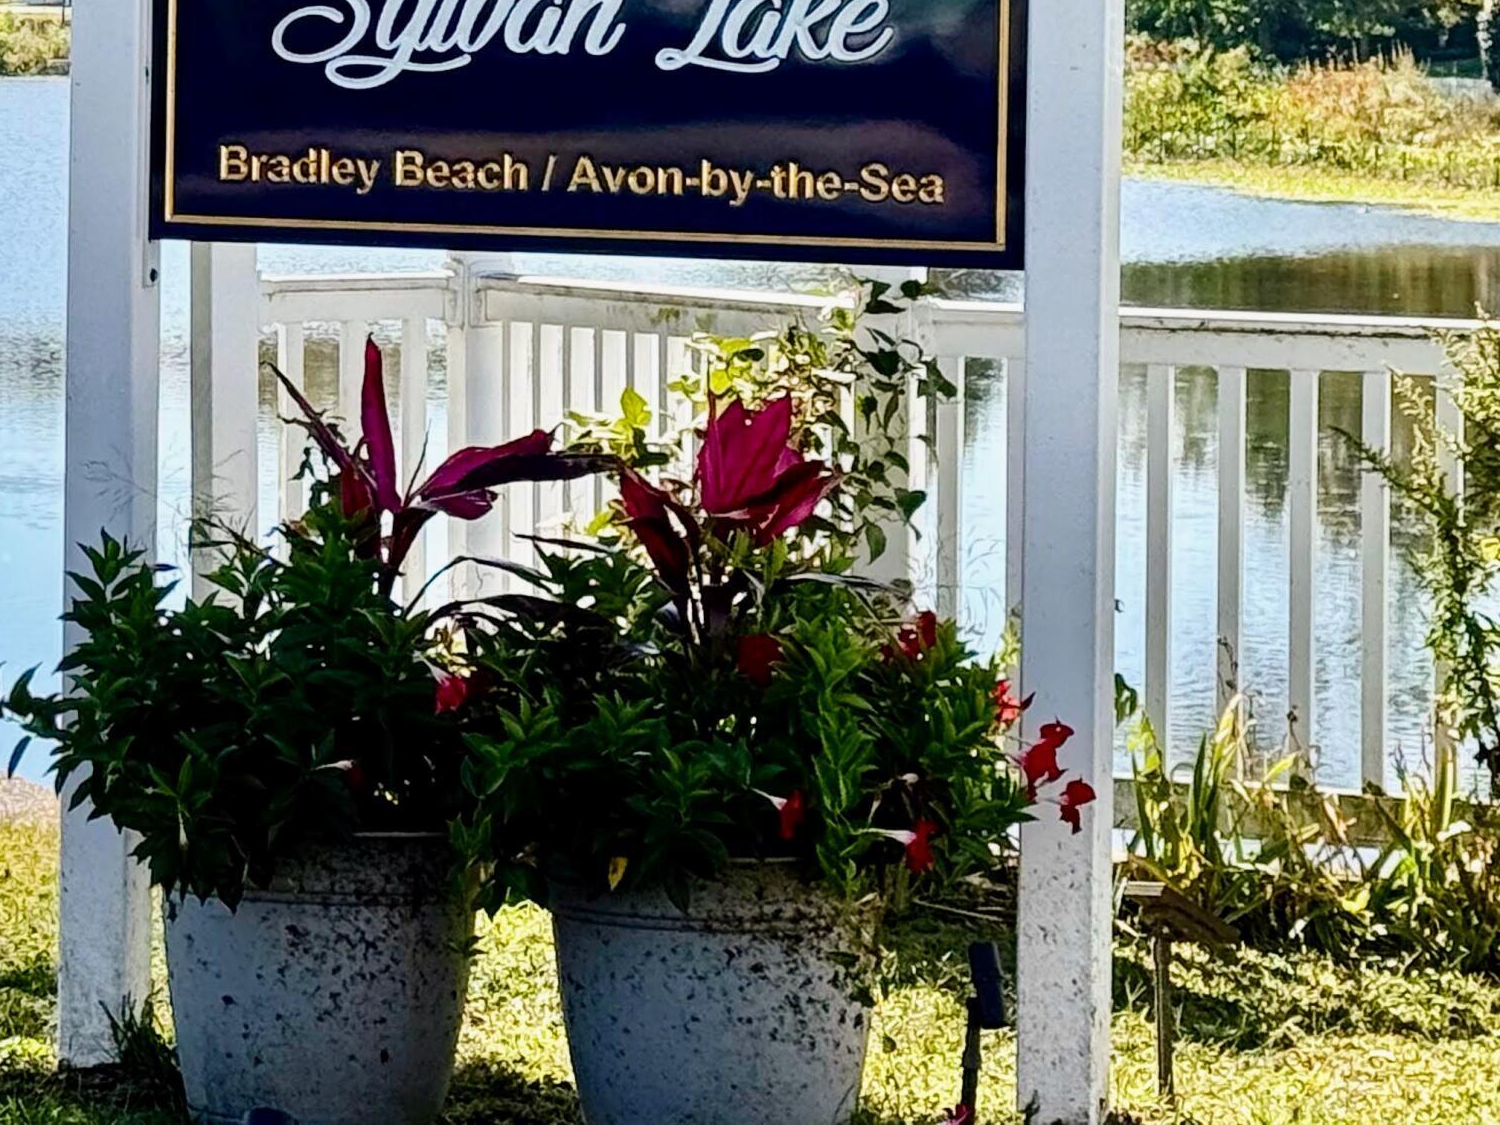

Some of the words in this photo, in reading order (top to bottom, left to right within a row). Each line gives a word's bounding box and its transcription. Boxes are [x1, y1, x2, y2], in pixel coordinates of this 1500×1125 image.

[217, 144, 380, 194] Bradley
[393, 150, 529, 193] Beach
[541, 153, 556, 193] /
[567, 155, 946, 208] Avon-by-the-Sea
